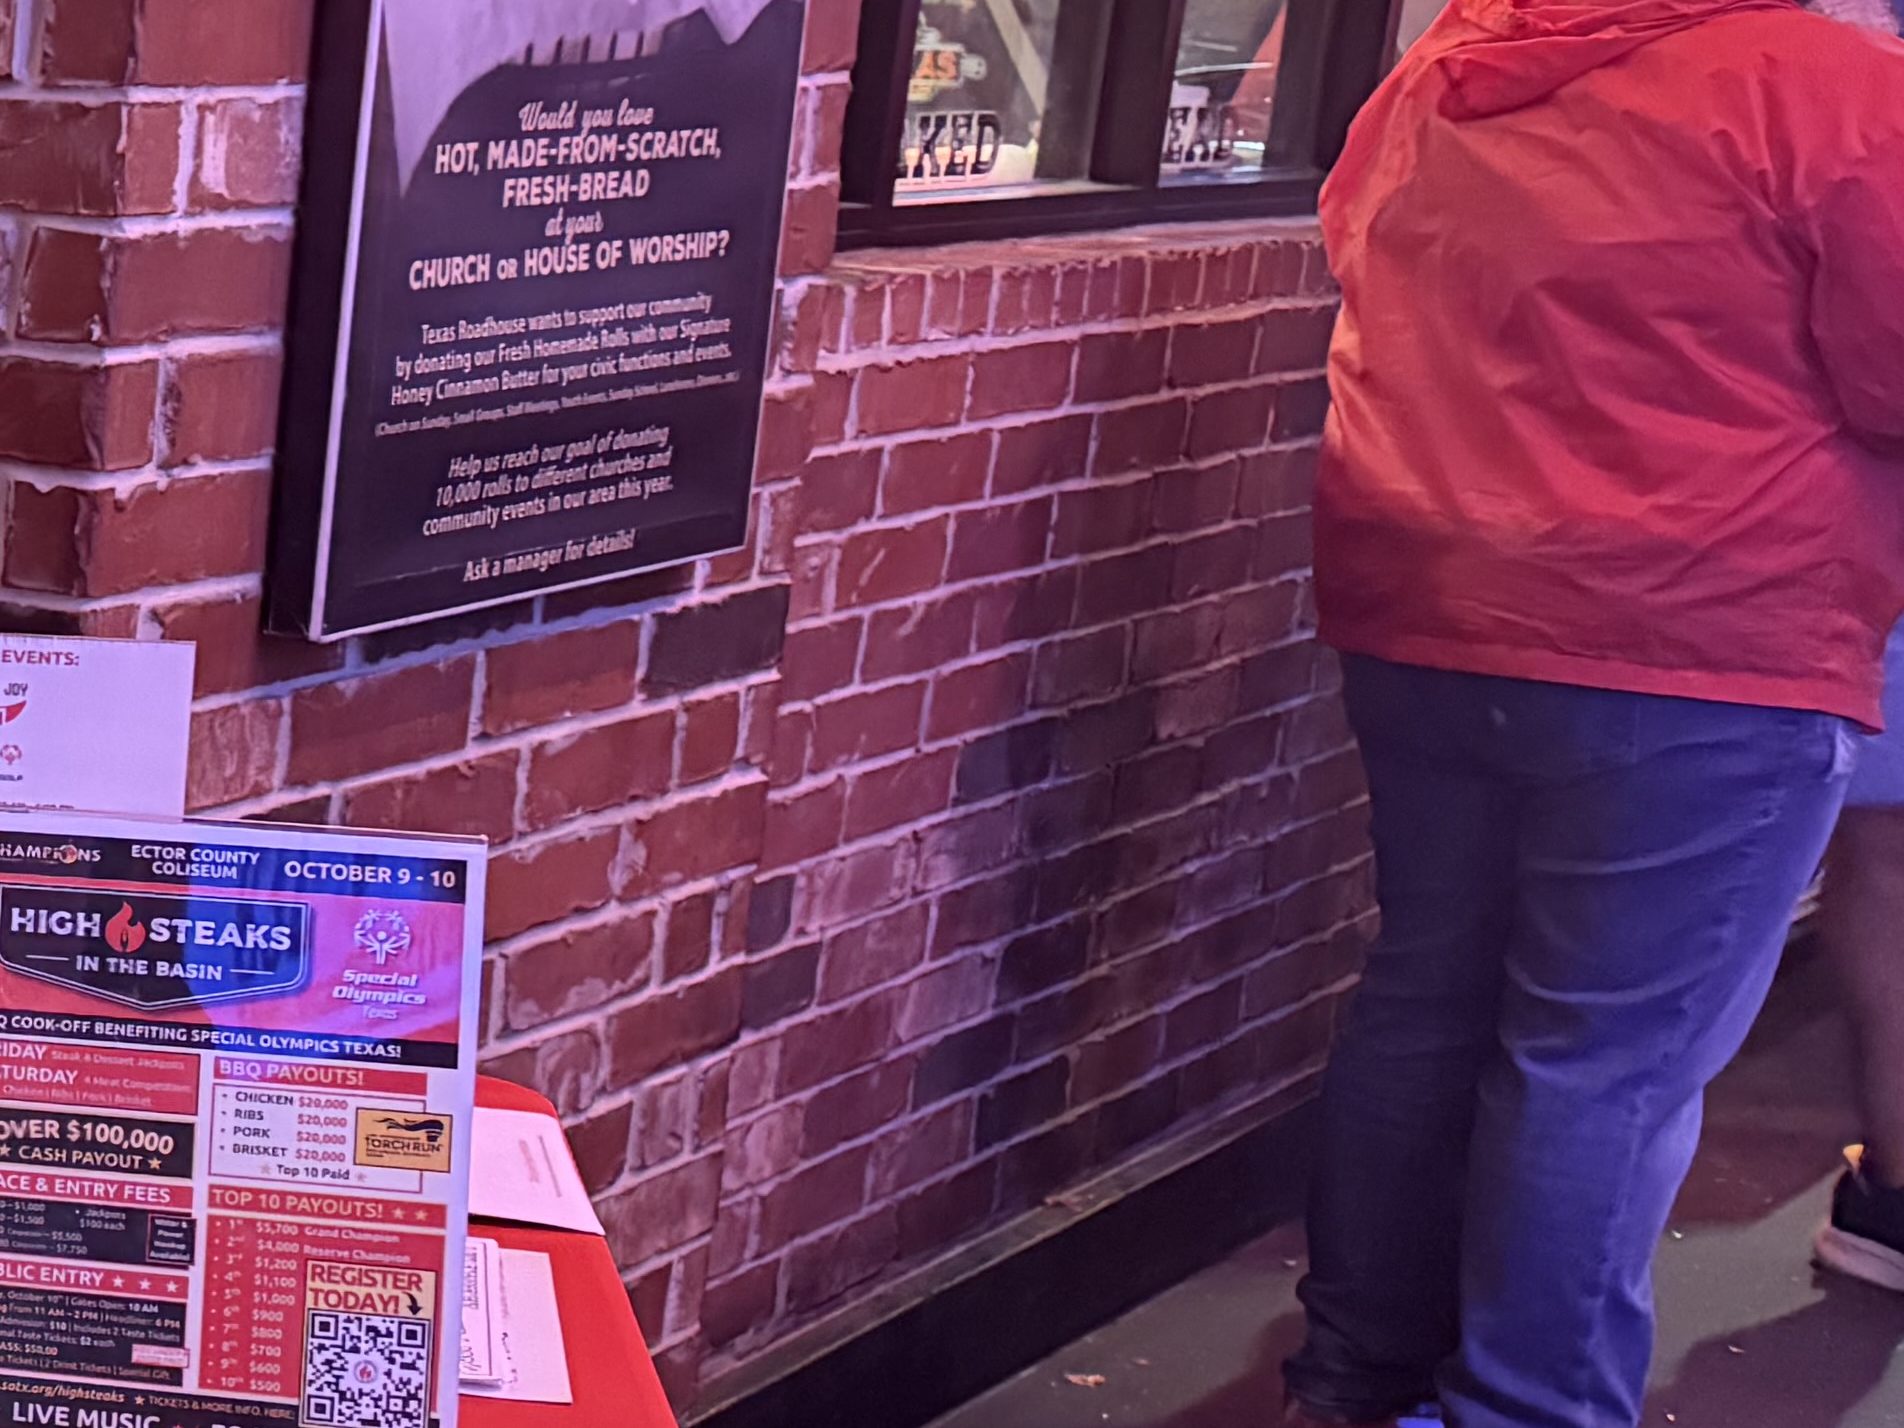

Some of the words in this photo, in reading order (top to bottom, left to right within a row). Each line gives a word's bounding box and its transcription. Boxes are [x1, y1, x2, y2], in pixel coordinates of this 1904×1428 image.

[518, 101, 577, 132] Would
[581, 108, 612, 139] you
[616, 98, 654, 128] love
[434, 142, 480, 176] HOT,
[487, 127, 721, 171] MADE-FROM-SCRATCH,
[502, 169, 651, 208] FRESH-BREAD
[545, 207, 563, 237] at
[409, 253, 491, 291] CHURCH
[524, 243, 591, 278] HOUSE
[596, 240, 623, 269] OF
[629, 230, 730, 265] WORSHIP?
[421, 322, 456, 346] Texas
[458, 317, 526, 341] Roadhouse
[528, 313, 563, 331] wants
[578, 302, 625, 327] support
[626, 303, 647, 318] our
[395, 356, 411, 381] by
[414, 350, 472, 374] donating
[474, 348, 496, 367] our
[498, 341, 531, 363] Fresh
[533, 332, 599, 357] Homemade
[659, 324, 679, 341] our
[391, 382, 434, 407] Honey
[561, 364, 588, 386] your
[447, 454, 481, 479] Help
[483, 454, 500, 472] us
[502, 444, 539, 469] reach
[541, 444, 566, 462] our
[565, 434, 597, 463] goal
[597, 431, 615, 453] of
[422, 504, 500, 536] community
[502, 496, 547, 521] events
[547, 492, 561, 511] in
[563, 490, 586, 509] our
[588, 485, 616, 505] area
[463, 558, 491, 582] Ask
[492, 558, 501, 577] a
[503, 546, 564, 574] manager
[1, 649, 80, 666] EVENTS:
[4, 682, 28, 696] JOY
[131, 844, 186, 861] ECTOR
[190, 848, 260, 866] COUNTY
[284, 860, 392, 884] OCTOBER
[397, 868, 411, 885] 9
[430, 870, 456, 888] 10
[152, 860, 238, 880] COLISEUM
[10, 907, 101, 938] HIGH
[148, 917, 293, 952] STEAKS
[76, 954, 99, 971] IN
[106, 957, 148, 975] THE
[156, 960, 223, 982] BASIN
[343, 968, 418, 988] Special
[332, 986, 427, 1005] Olympics
[11, 1015, 91, 1033] COOK-OFF
[94, 1023, 188, 1042] BENEFITING
[190, 1029, 256, 1047] SPECIAL
[259, 1034, 340, 1053] OLYMPICS
[342, 1041, 402, 1058] TEXAS!
[219, 1059, 262, 1079] BBQ
[267, 1062, 364, 1086] PAYOUTS!
[235, 1091, 294, 1106] CHICKEN
[234, 1109, 265, 1121] RIBS
[66, 1119, 174, 1155] $100,000
[233, 1126, 271, 1139] PORK
[365, 1136, 411, 1151] TORCH
[18, 1145, 67, 1164] CASH
[71, 1150, 144, 1169] PAYOUT
[232, 1143, 288, 1158] BRISKET
[54, 1179, 119, 1200] ENTRY
[123, 1184, 171, 1204] FEES
[212, 1188, 253, 1206] TOP
[259, 1193, 280, 1209] 10
[285, 1195, 384, 1219] PAYOUTS!
[41, 1269, 104, 1288] ENTRY
[310, 1263, 423, 1292] REGISTER
[309, 1288, 400, 1314] TODAY!
[249, 1378, 281, 1392] $500
[11, 1401, 70, 1428] LIVE
